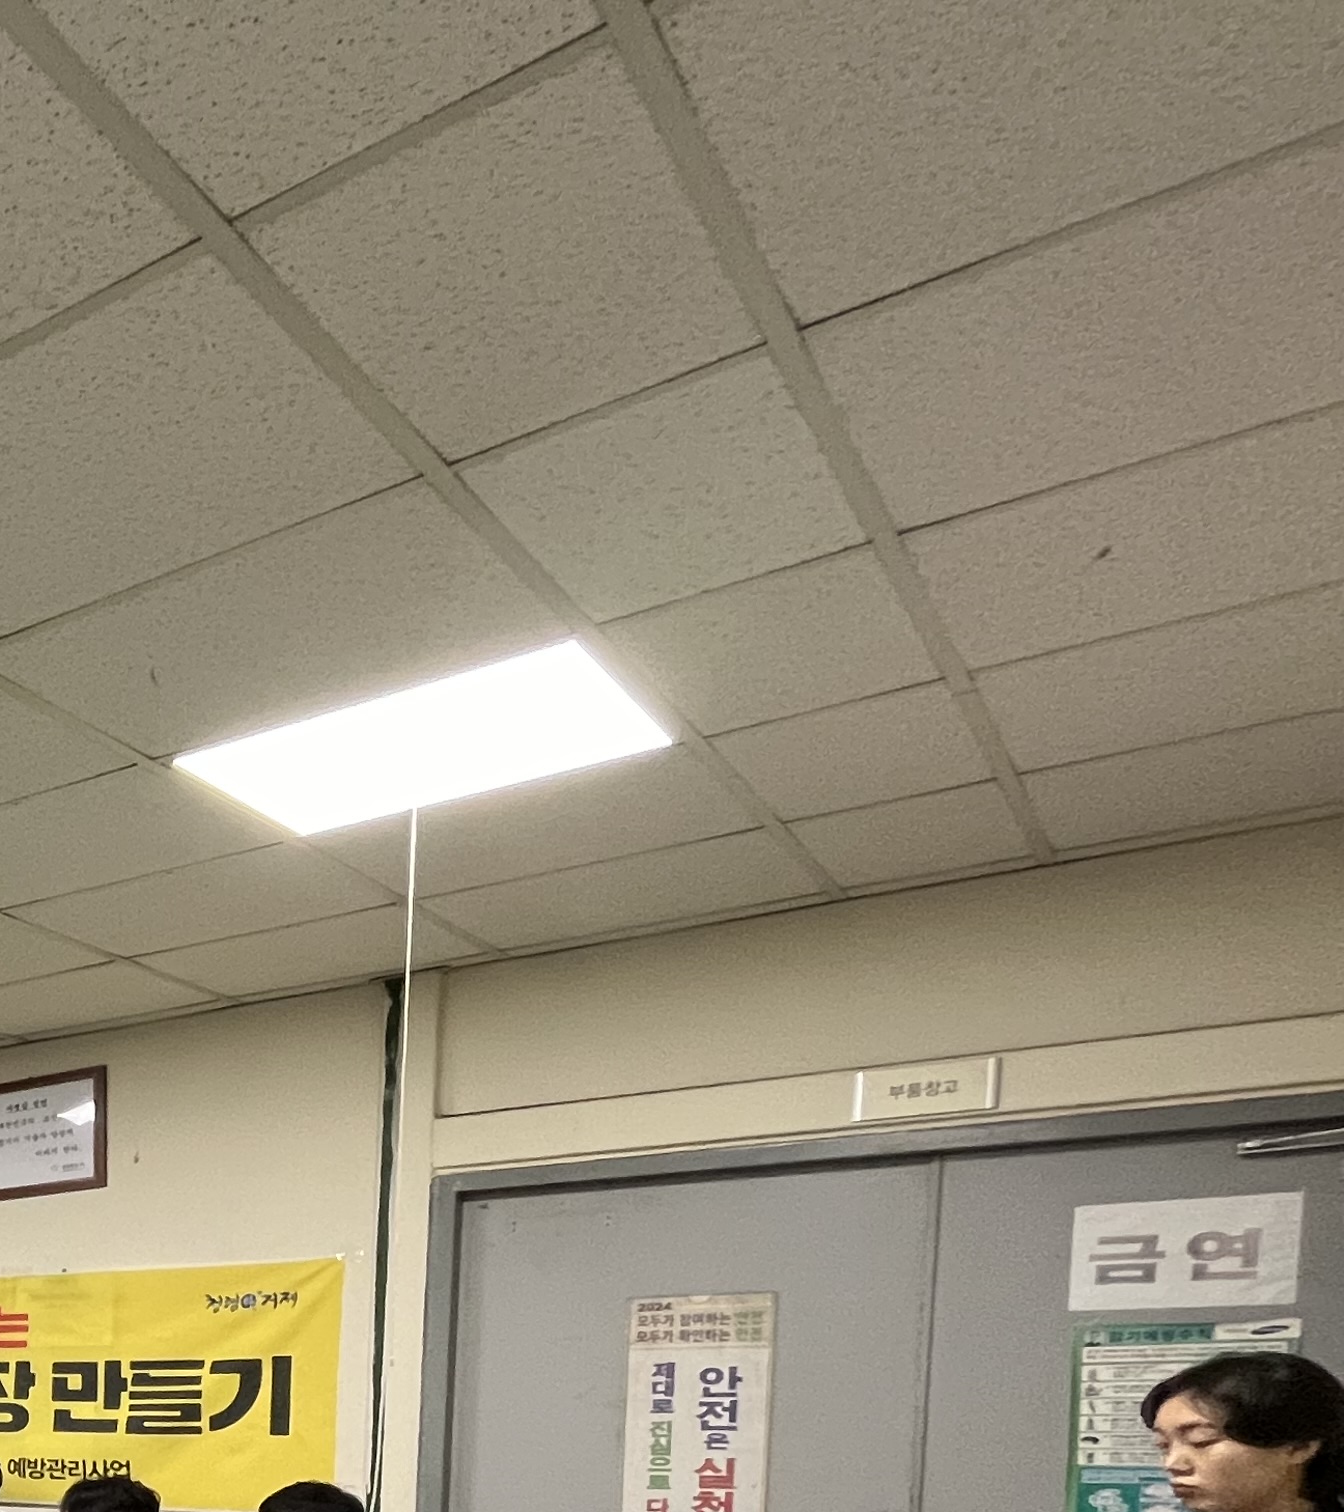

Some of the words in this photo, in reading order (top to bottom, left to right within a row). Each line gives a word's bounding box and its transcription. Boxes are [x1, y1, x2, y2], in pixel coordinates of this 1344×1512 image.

[1088, 1227, 1263, 1286] 금연
[636, 1314, 674, 1327] 모두가
[637, 1302, 672, 1312] 2024
[635, 1329, 673, 1343] 모두가
[52, 1355, 293, 1436] 만들기
[650, 1361, 676, 1414] 제대로
[696, 1365, 743, 1450] 안전은
[8, 1457, 131, 1480] 예방관리사업
[646, 1419, 673, 1490] 진심으로
